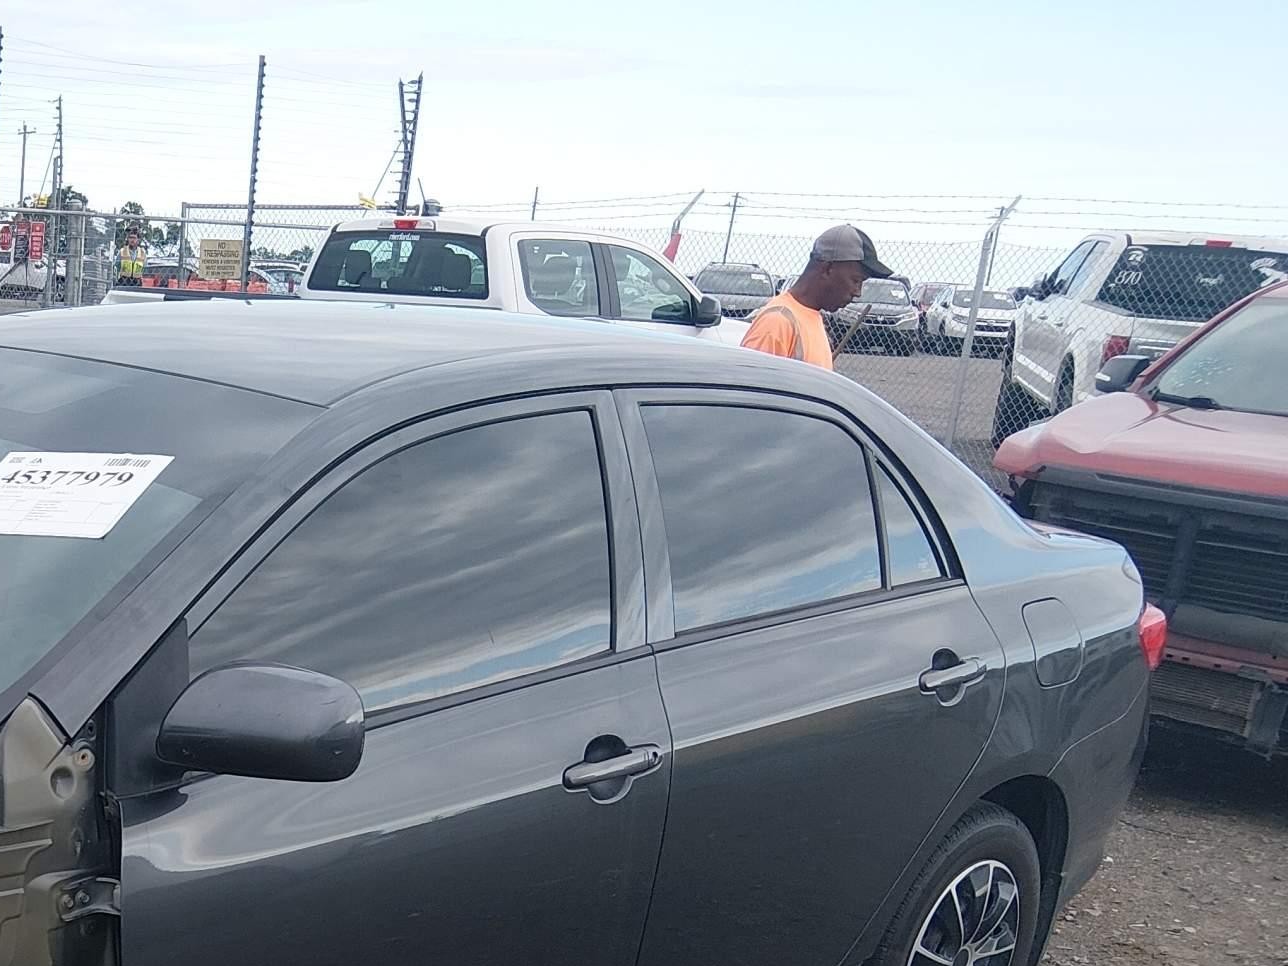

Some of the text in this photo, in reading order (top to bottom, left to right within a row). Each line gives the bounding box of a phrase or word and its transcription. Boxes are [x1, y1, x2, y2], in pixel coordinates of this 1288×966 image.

[204, 250, 239, 258] TRESPASSING
[1115, 270, 1143, 286] 870
[1, 470, 134, 487] 45377979
